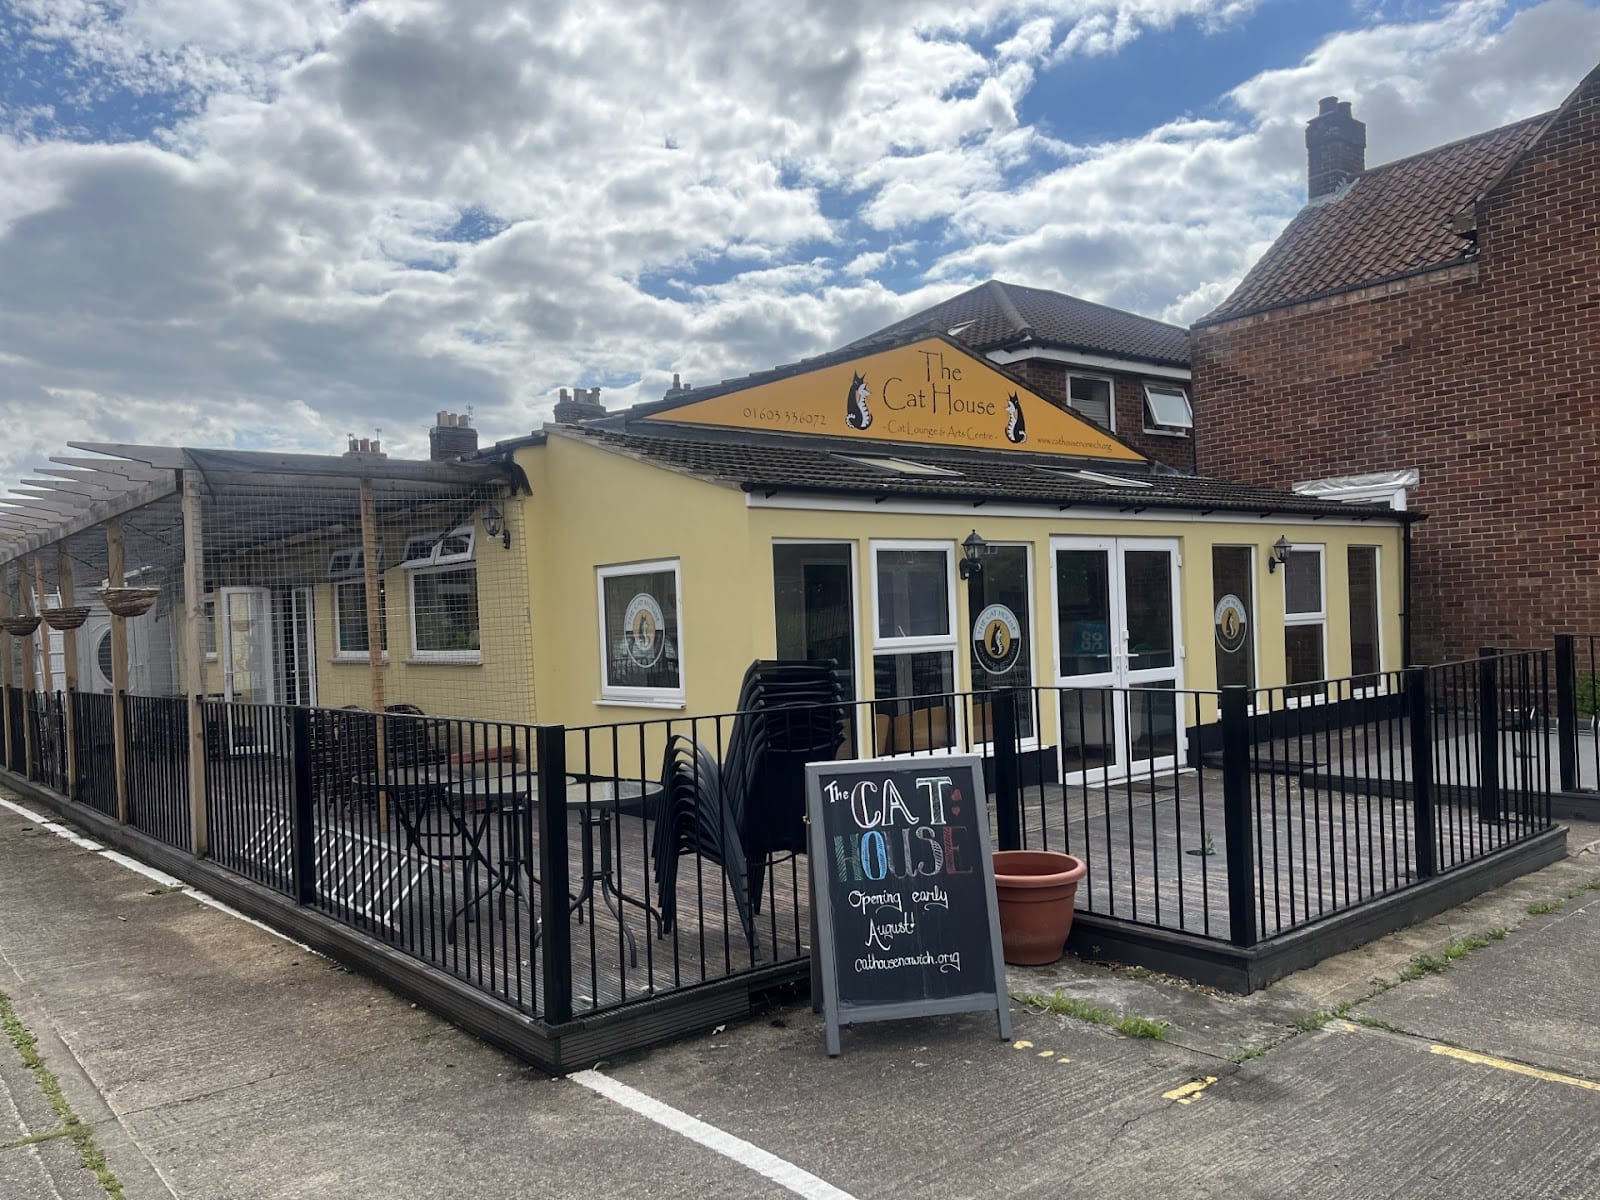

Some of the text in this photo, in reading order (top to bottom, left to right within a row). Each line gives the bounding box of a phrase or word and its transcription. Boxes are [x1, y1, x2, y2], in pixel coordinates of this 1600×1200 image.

[918, 350, 962, 382] The
[883, 377, 996, 416] Cat House
[743, 407, 827, 429] 01603 336072
[887, 419, 906, 434] Cat
[906, 421, 938, 439] Lounge
[948, 425, 966, 439] Arts
[966, 427, 993, 441] Centre
[824, 776, 953, 829] The CAT
[833, 826, 974, 883] HOUSE
[848, 884, 949, 915] Opening early
